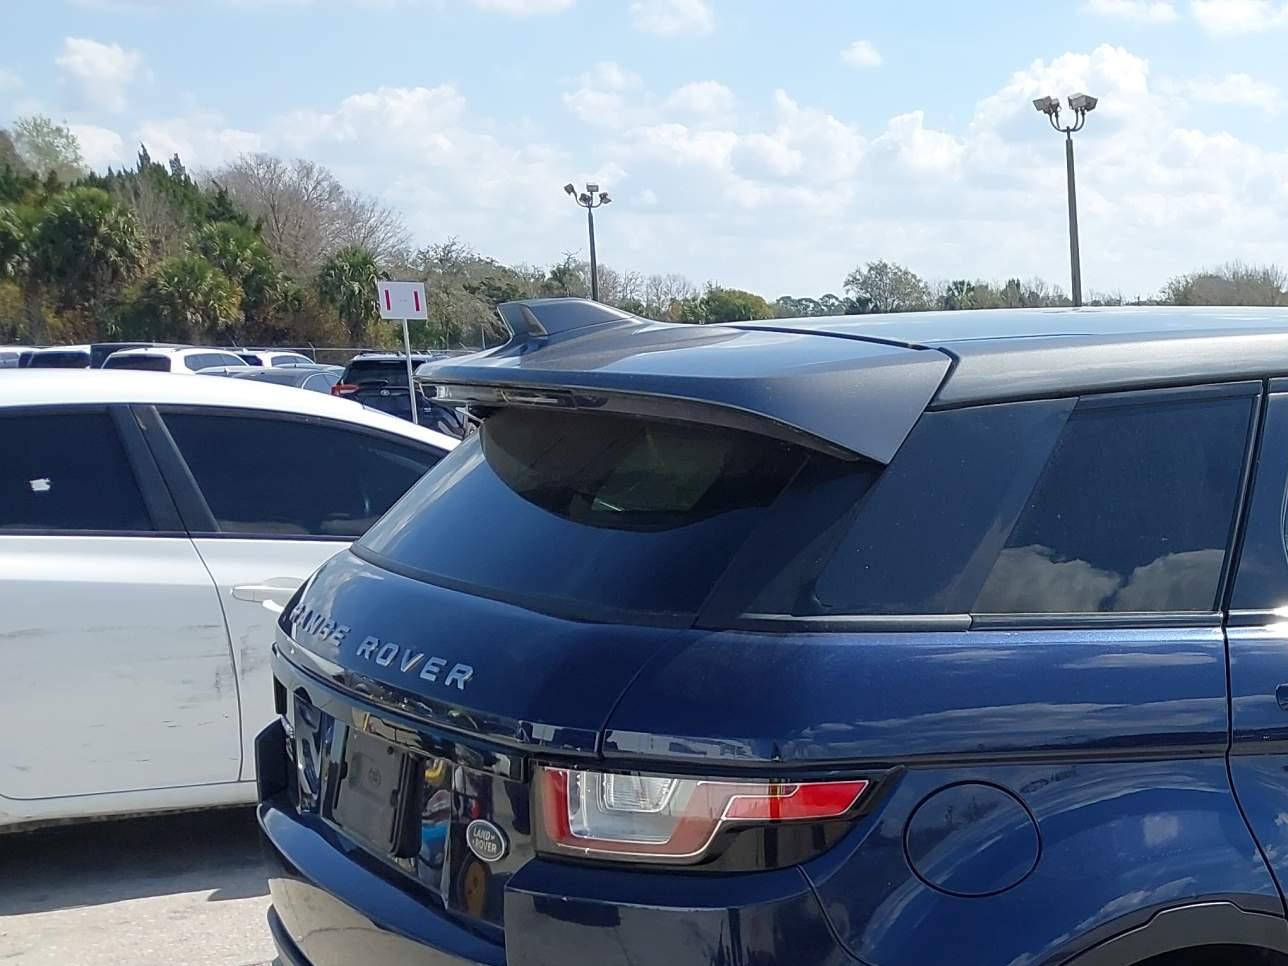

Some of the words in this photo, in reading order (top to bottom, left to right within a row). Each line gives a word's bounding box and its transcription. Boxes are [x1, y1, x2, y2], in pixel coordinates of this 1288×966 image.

[289, 603, 351, 647] RANGE
[356, 635, 474, 690] ROVER
[473, 827, 491, 841] LAND
[475, 838, 497, 854] ROVER
